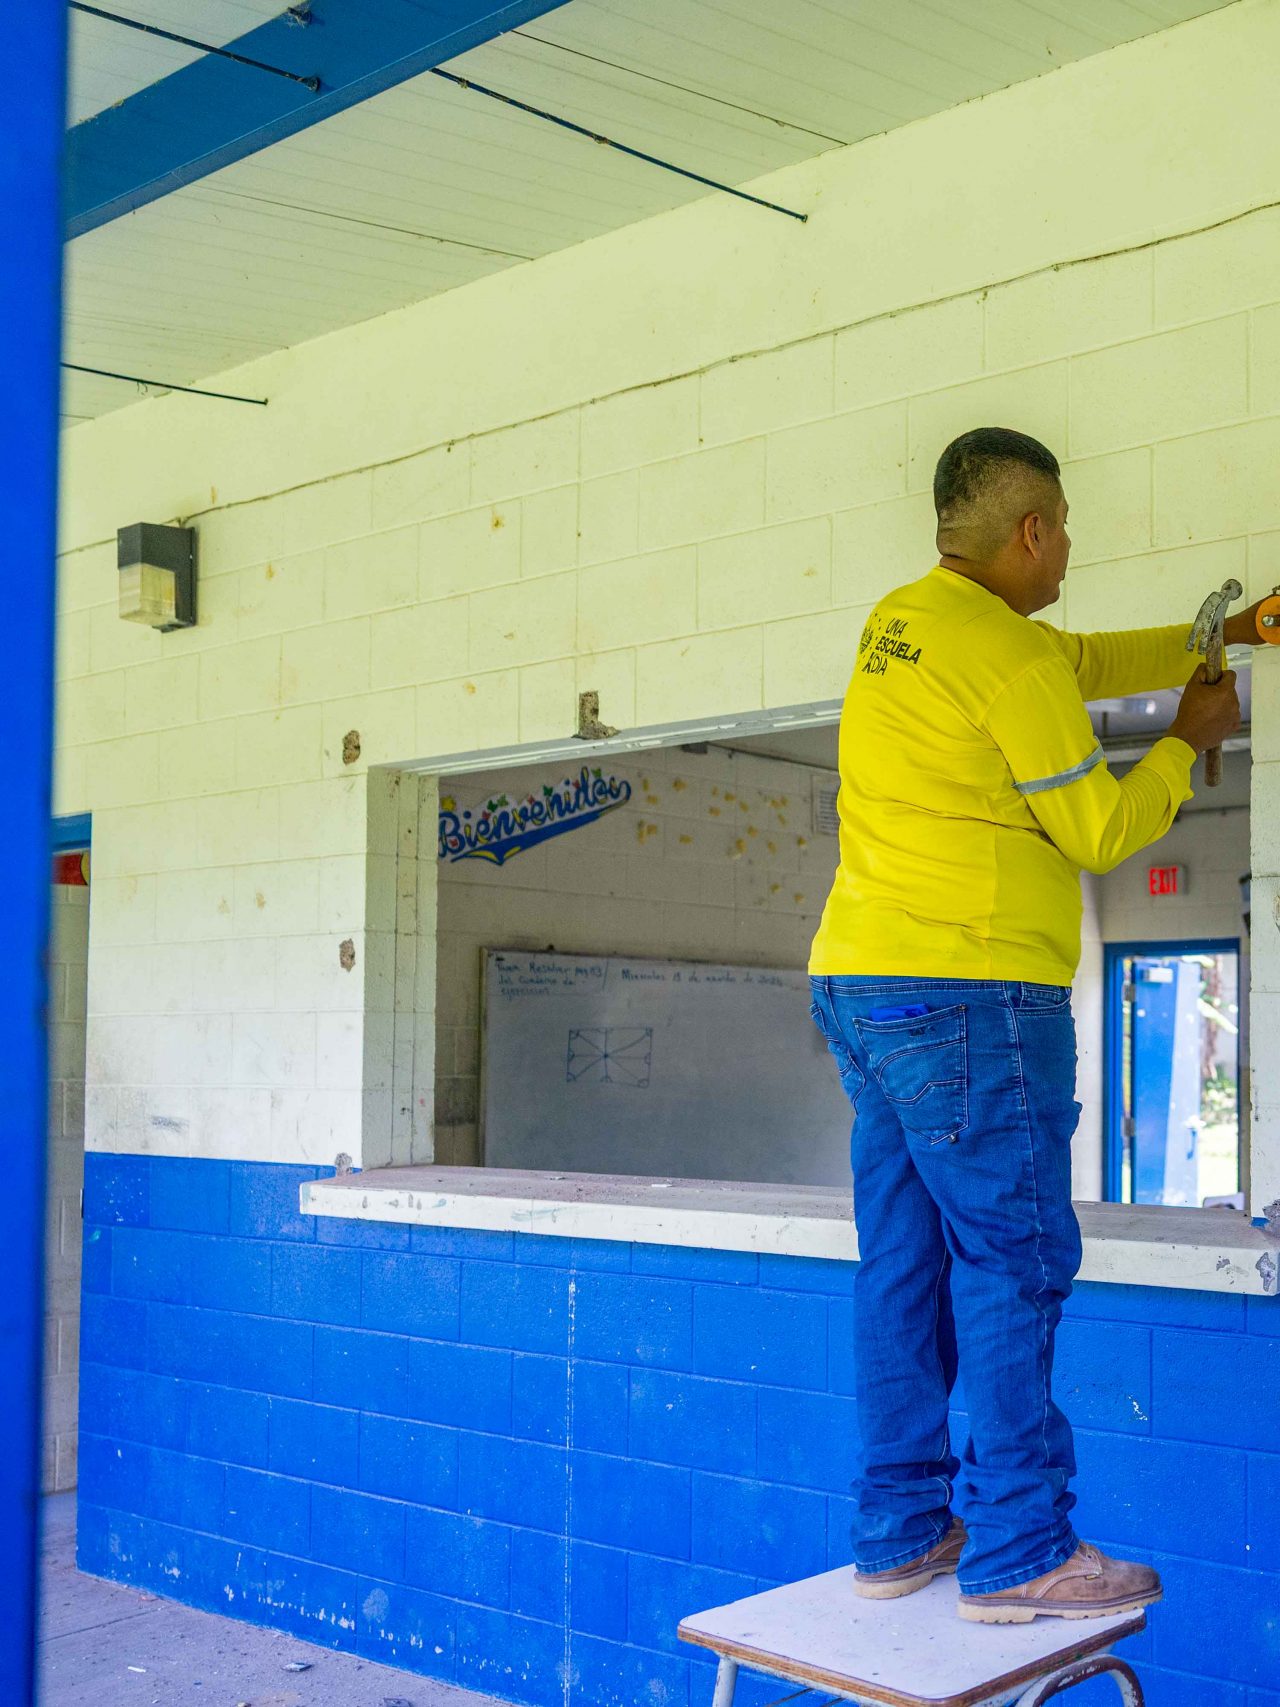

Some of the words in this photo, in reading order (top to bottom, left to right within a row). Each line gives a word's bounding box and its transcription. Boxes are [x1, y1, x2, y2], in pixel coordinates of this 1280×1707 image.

[885, 617, 909, 638] UNA
[875, 635, 922, 665] ESCUELA
[438, 766, 632, 860] Bienvenidos
[1150, 866, 1178, 896] EXIT
